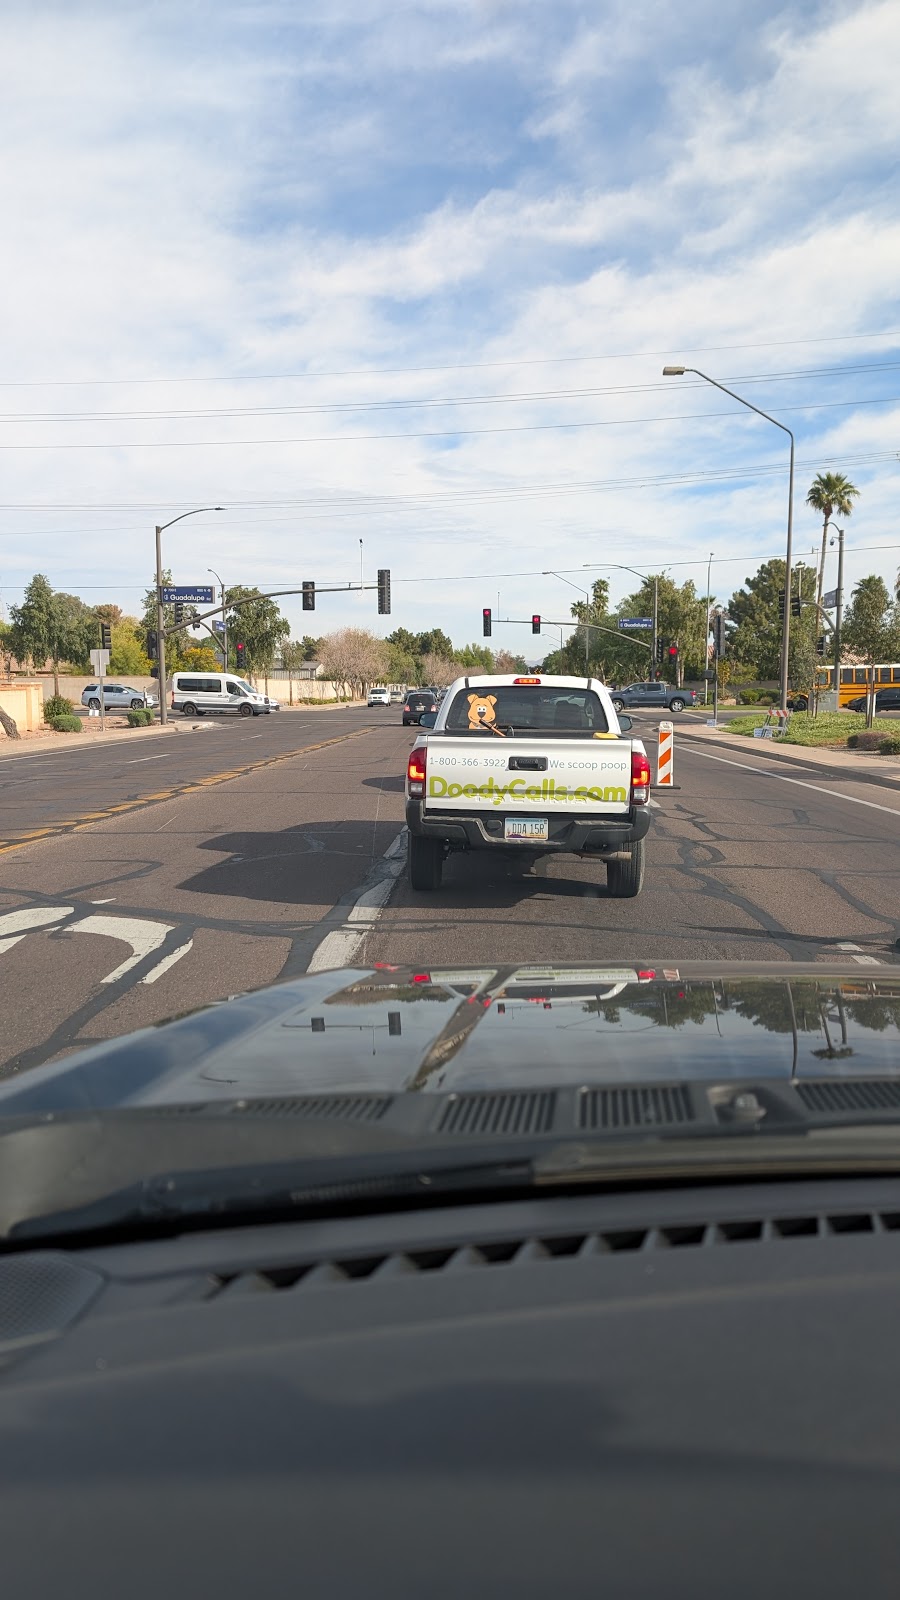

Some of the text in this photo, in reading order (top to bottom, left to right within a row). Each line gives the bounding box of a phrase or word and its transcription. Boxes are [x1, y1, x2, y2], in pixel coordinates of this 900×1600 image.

[170, 594, 205, 602] Guadalupe
[429, 757, 506, 767] 1-800-366-3922
[549, 759, 630, 771] We scoop poop.
[429, 776, 627, 805] DoodyCalls.com
[529, 823, 545, 835] 15R
